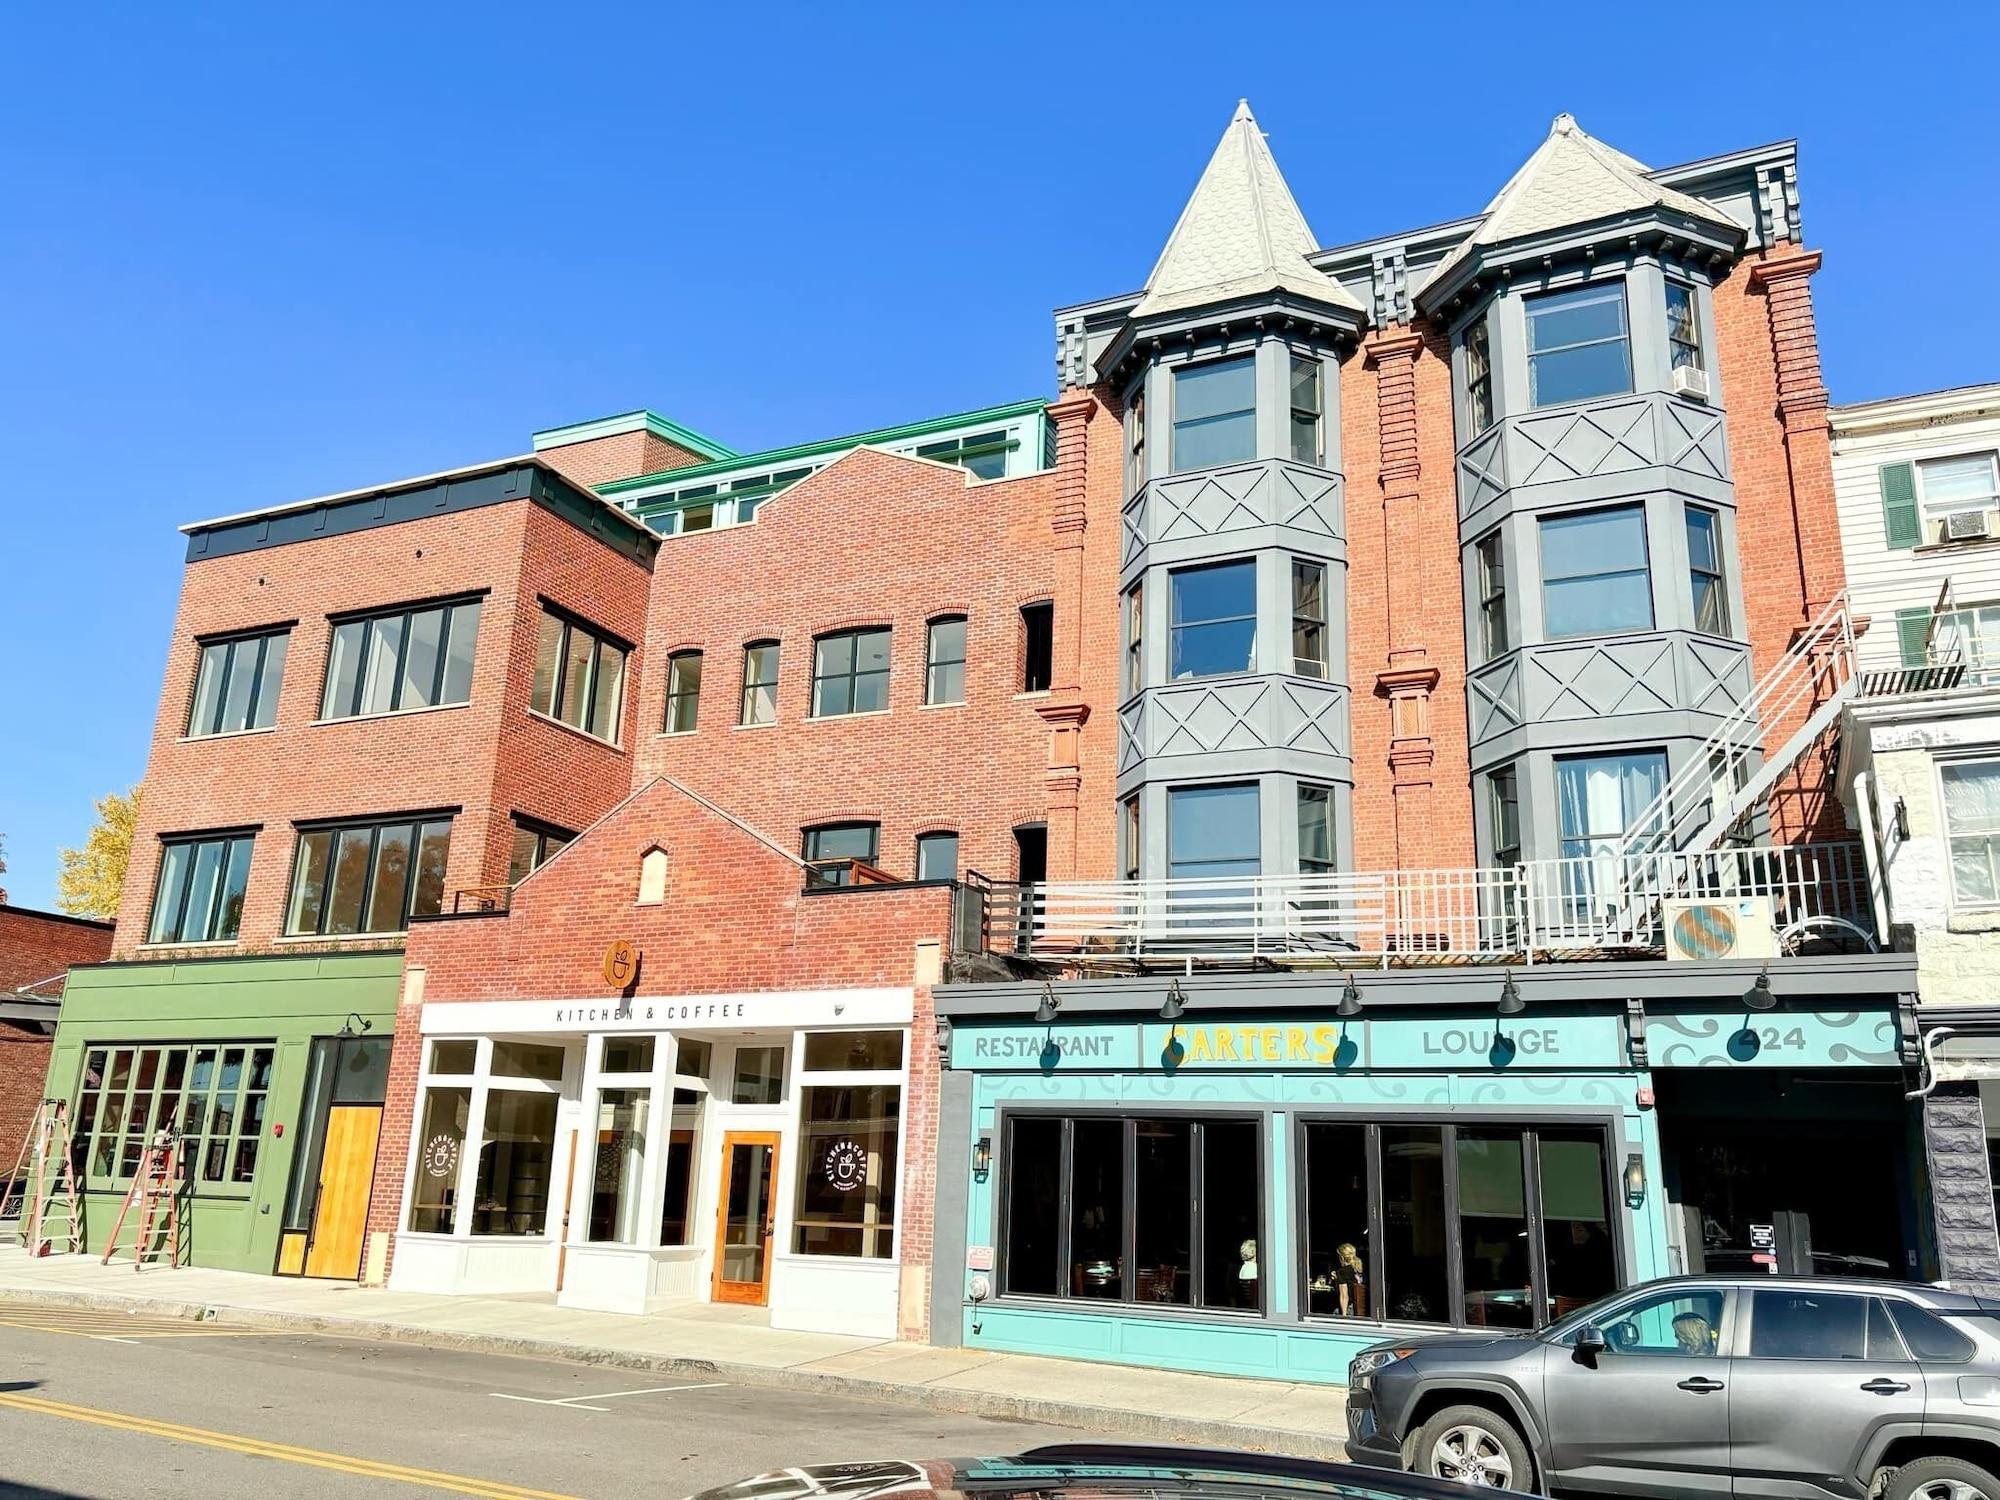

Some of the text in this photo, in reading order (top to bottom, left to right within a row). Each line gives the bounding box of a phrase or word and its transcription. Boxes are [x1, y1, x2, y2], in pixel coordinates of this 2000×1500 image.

[556, 1003, 744, 1022] KITCHEN & COFFEE
[975, 1035, 1114, 1058] RESTAURANT
[1163, 1025, 1339, 1066] CARTERS
[1423, 1029, 1560, 1055] LOUNGE
[1738, 1027, 1807, 1050] 424
